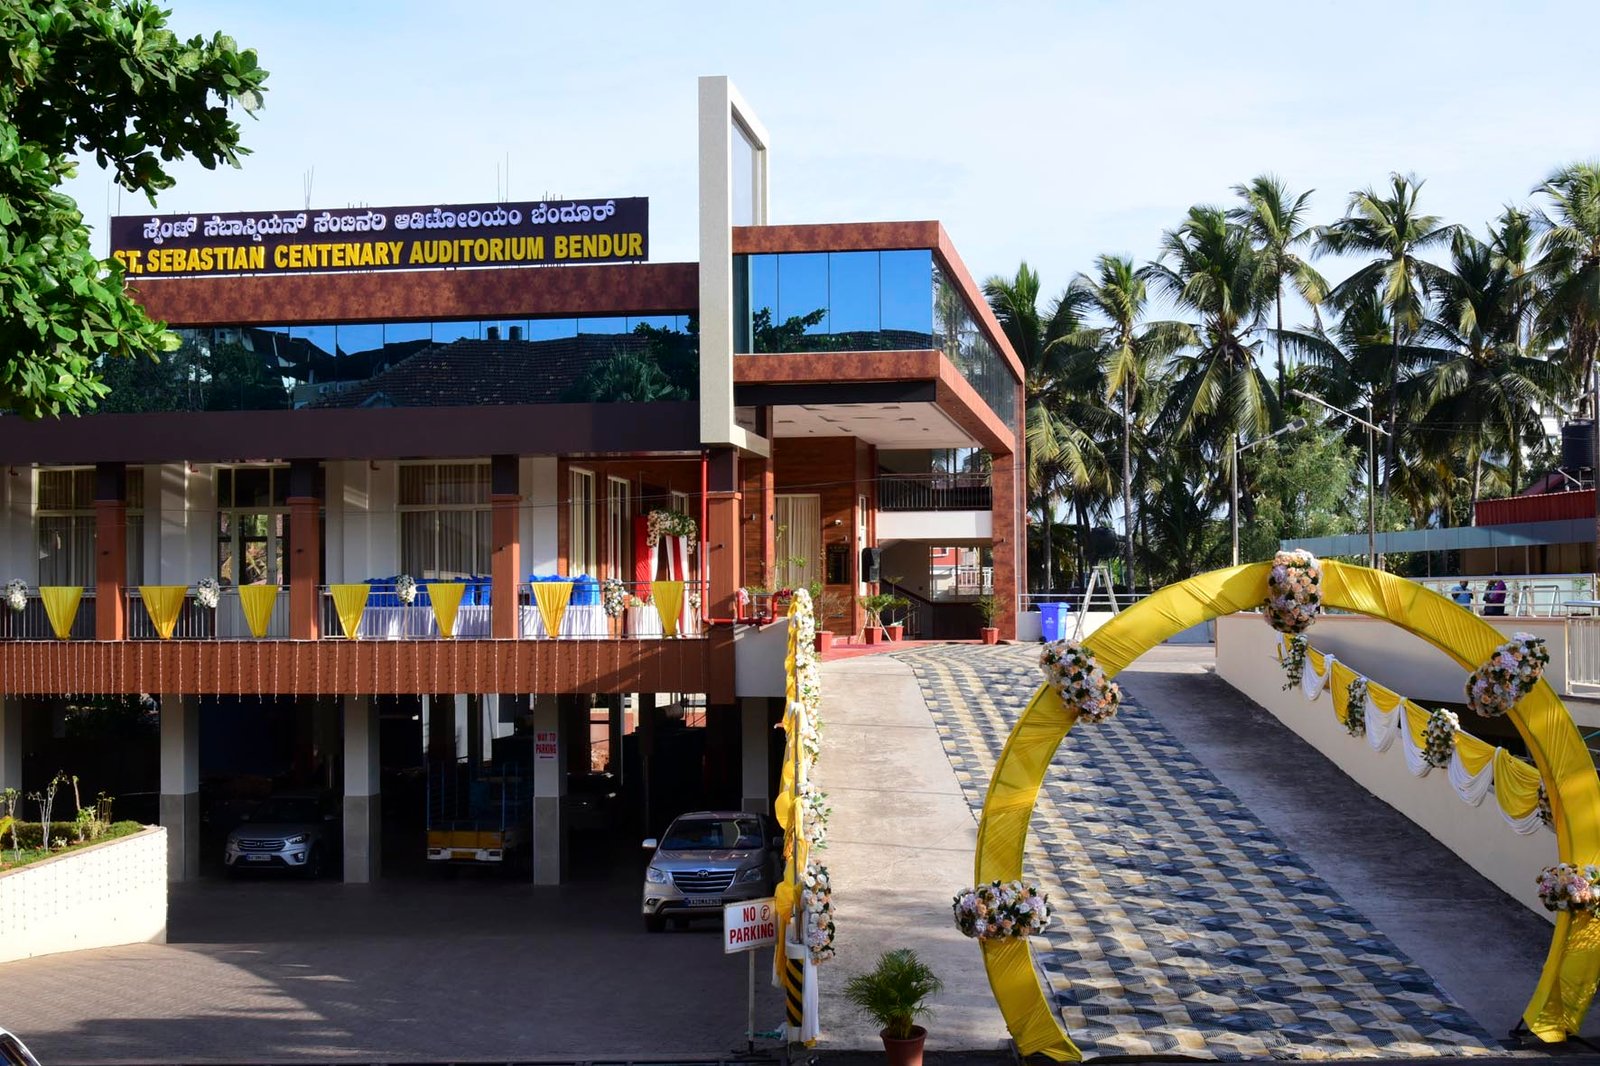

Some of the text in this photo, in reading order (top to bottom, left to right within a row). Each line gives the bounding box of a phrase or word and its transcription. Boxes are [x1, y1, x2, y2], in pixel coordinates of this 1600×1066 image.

[113, 233, 643, 274] ST. SEBASTIAN CENTENARY AUDITORIUM BENDUR
[535, 743, 557, 754] PARKING
[743, 906, 756, 922] NO
[729, 922, 774, 944] PARKING
